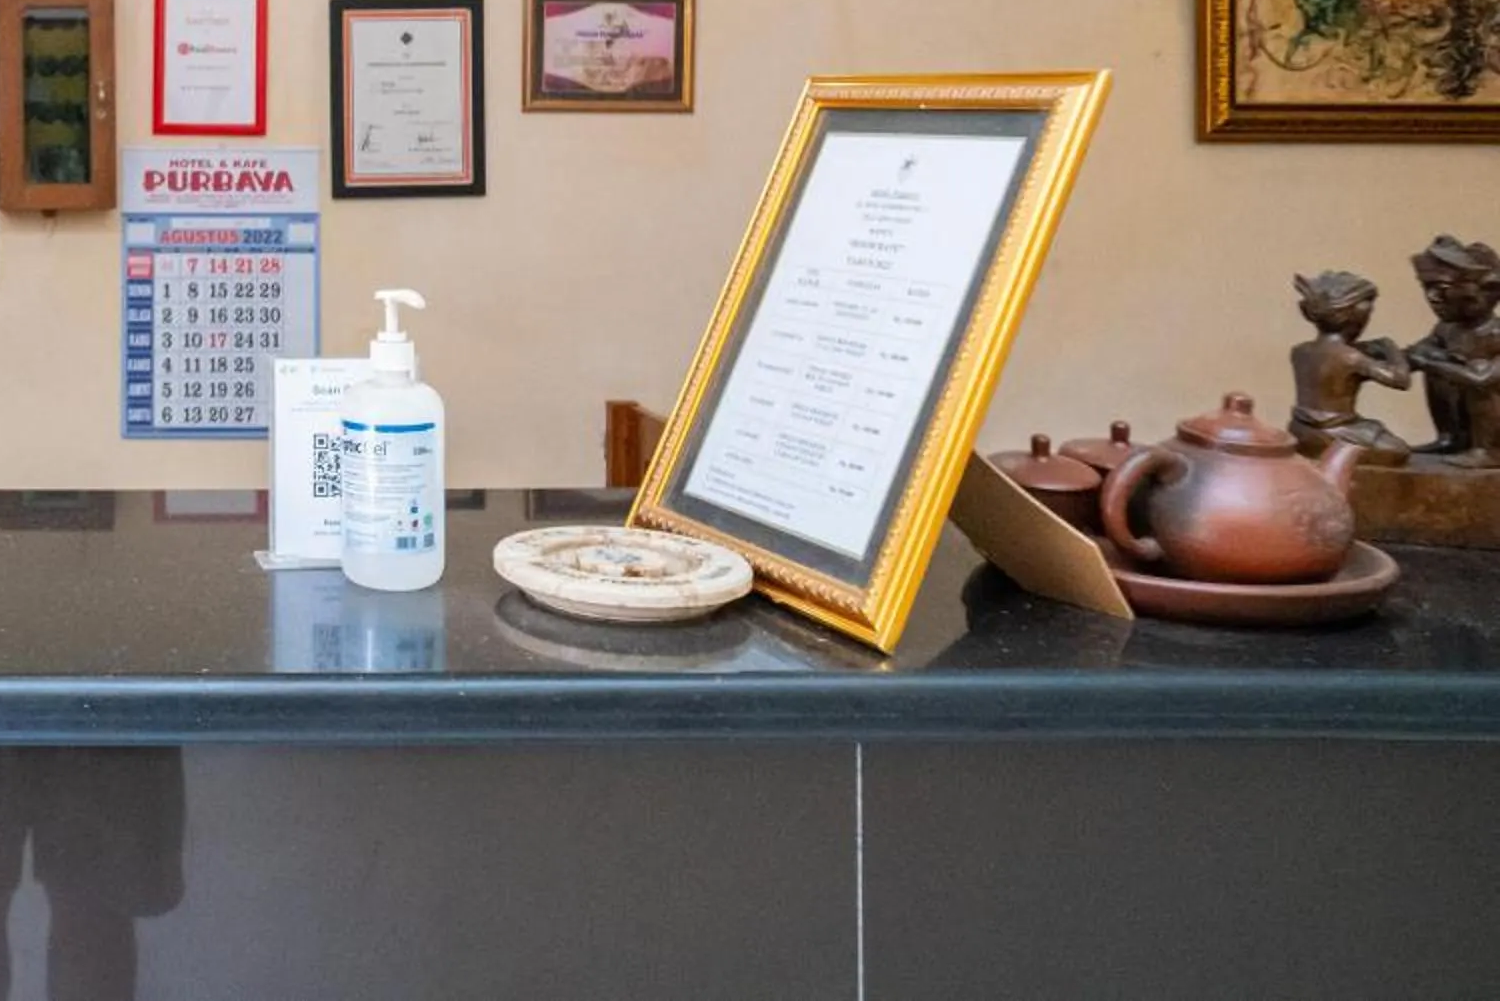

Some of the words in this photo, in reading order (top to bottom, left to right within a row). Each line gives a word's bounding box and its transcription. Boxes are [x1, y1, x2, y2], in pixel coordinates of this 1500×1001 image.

[159, 230, 239, 245] AGUSTUS
[243, 230, 284, 245] 2022
[187, 258, 198, 273] 7
[210, 258, 228, 273] 14
[235, 258, 253, 273] 21
[260, 258, 281, 273] 28
[163, 283, 171, 299] 1
[187, 283, 199, 299] 8
[210, 283, 228, 299] 15
[234, 283, 254, 299] 22
[260, 283, 281, 299] 29
[162, 307, 173, 324] 2
[187, 307, 199, 324] 9
[210, 307, 228, 324] 16
[234, 307, 254, 324] 23
[260, 307, 281, 324] 30
[162, 332, 173, 348] 3
[184, 332, 202, 348] 10
[210, 332, 227, 348] 17
[234, 332, 254, 348] 24
[260, 332, 280, 348] 31
[162, 357, 172, 374] 4
[184, 357, 200, 374] 11
[210, 357, 228, 374] 18
[234, 357, 254, 374] 25
[162, 382, 173, 398] 5
[184, 382, 202, 398] 12
[210, 382, 228, 398] 19
[234, 382, 254, 398] 26
[162, 407, 173, 423] 6
[184, 407, 202, 423] 13
[210, 407, 228, 423] 20
[234, 407, 255, 423] 27
